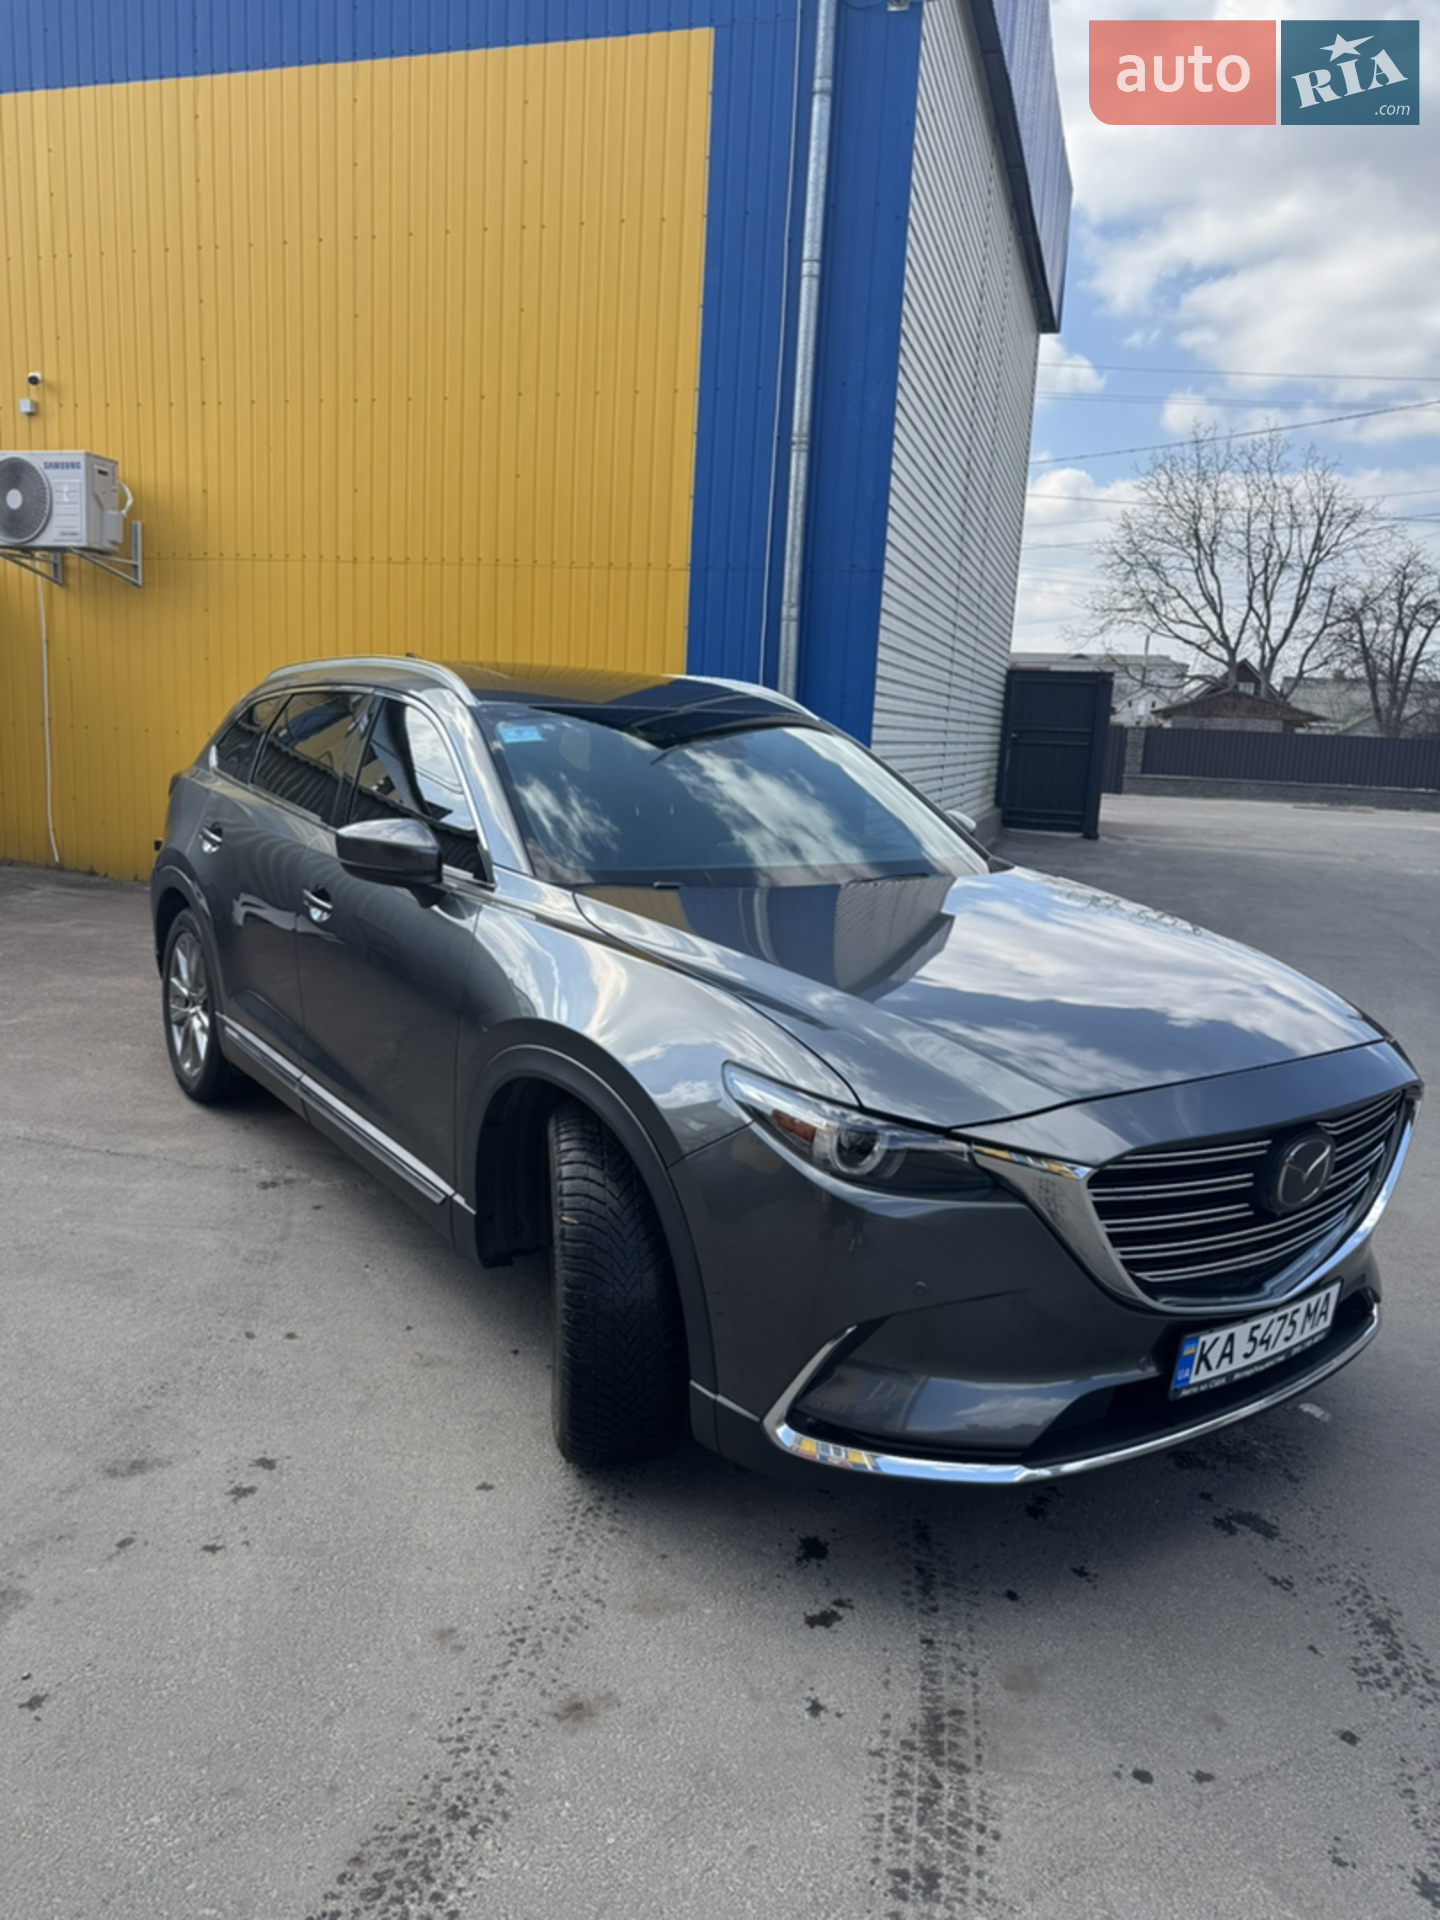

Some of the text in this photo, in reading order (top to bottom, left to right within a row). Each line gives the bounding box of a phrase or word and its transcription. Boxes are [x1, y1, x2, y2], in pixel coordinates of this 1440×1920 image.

[43, 461, 81, 470] SAMSUNG
[1194, 1333, 1235, 1376] KA
[1243, 1308, 1300, 1360] 5475
[1300, 1292, 1331, 1335] MA
